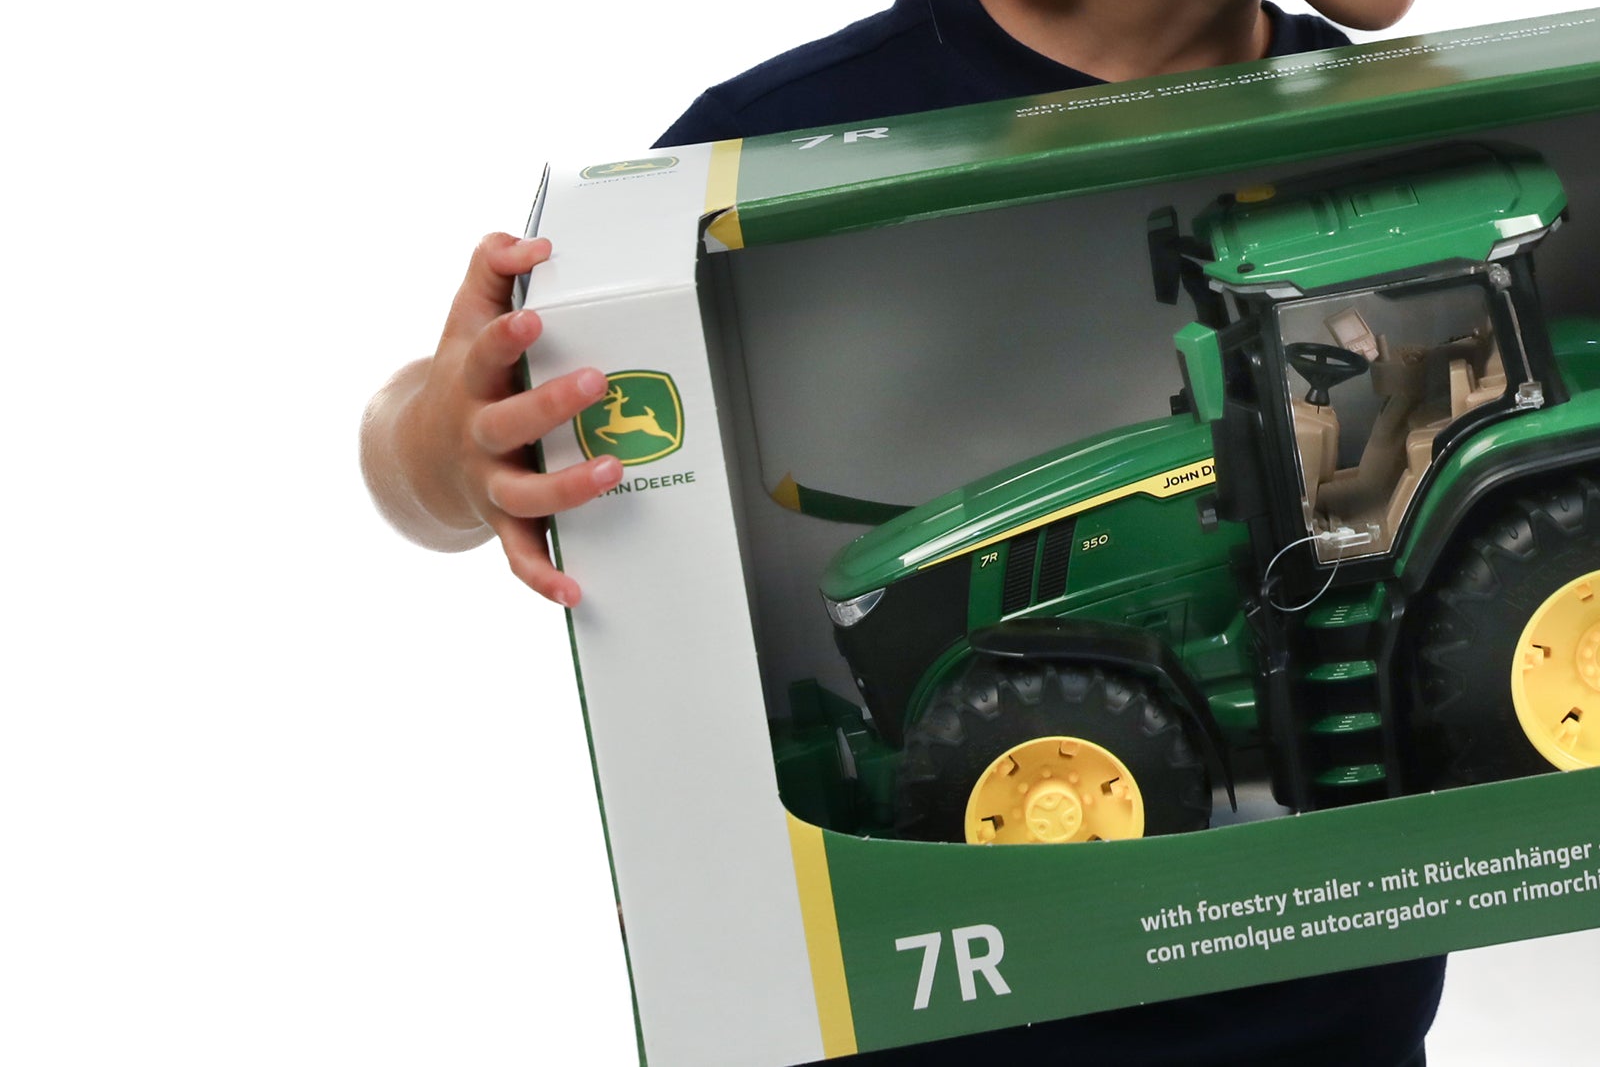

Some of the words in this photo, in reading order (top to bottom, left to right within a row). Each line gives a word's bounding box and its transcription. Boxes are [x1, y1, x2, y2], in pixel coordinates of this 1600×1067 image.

[791, 127, 889, 150] 7R
[634, 471, 696, 492] DEERE
[1163, 470, 1199, 489] JOHN
[1082, 534, 1109, 551] 350
[980, 551, 998, 568] 7R
[1141, 906, 1192, 932] with
[1197, 892, 1287, 923] forestry
[1292, 878, 1361, 908] trailer
[1381, 867, 1419, 892] mit
[1423, 841, 1592, 885] Rückeanhänger
[1146, 941, 1186, 964] con
[1191, 924, 1295, 957] remolque
[1300, 895, 1450, 938] autocargador
[1468, 888, 1507, 910] con
[894, 923, 1012, 1011] 7R
